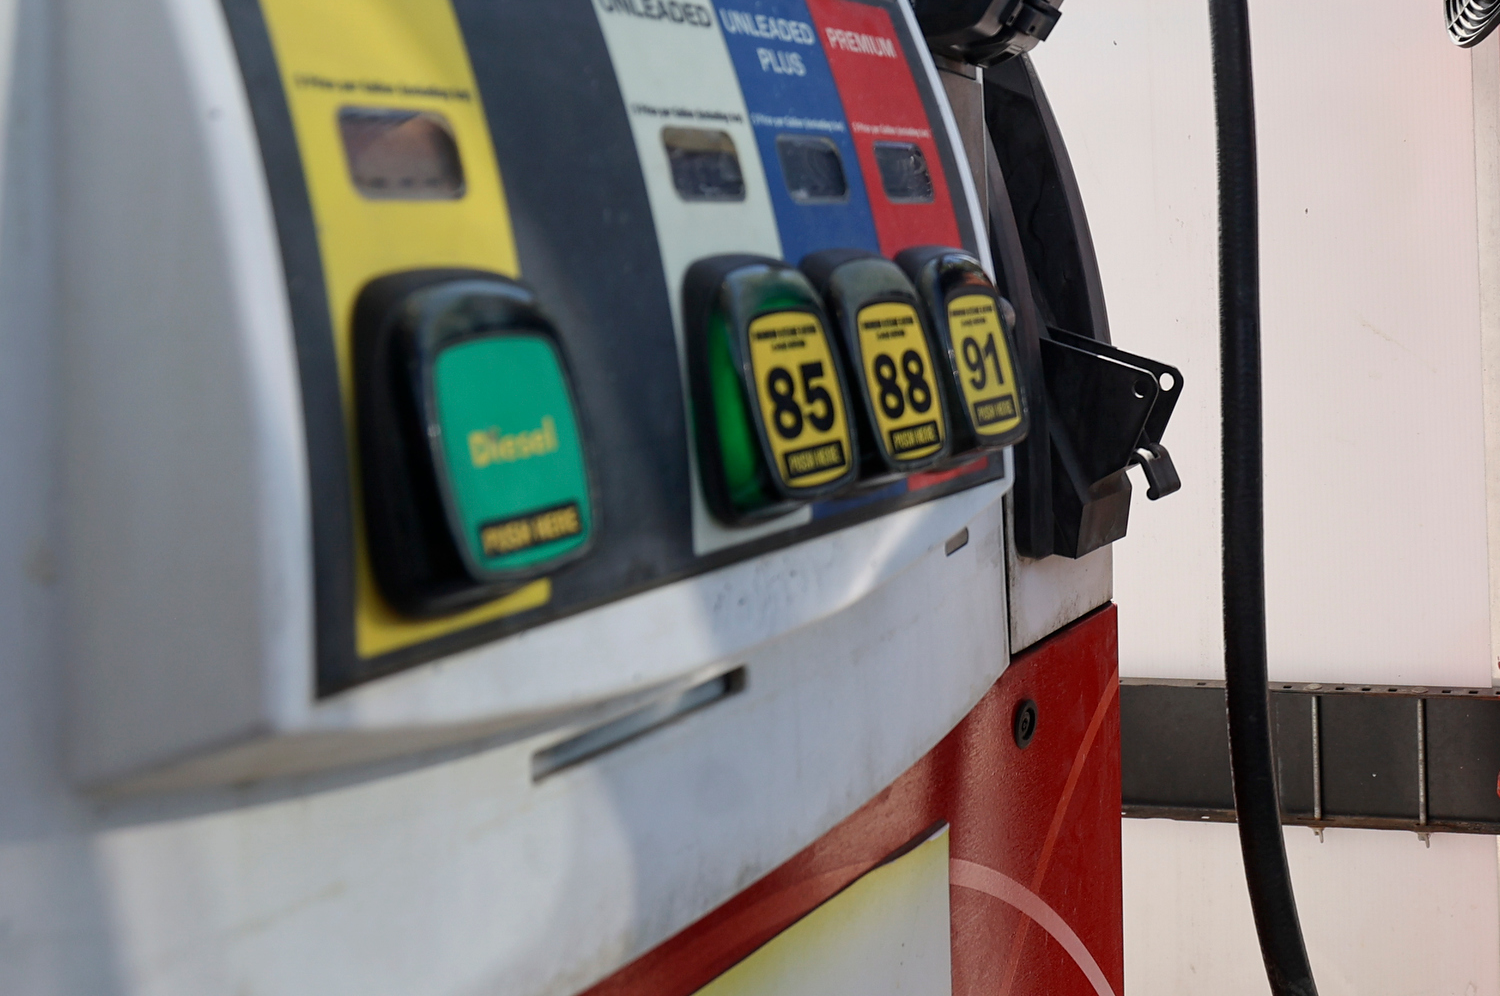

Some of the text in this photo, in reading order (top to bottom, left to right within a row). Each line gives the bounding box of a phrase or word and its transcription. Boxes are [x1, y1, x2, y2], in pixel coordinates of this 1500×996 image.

[719, 9, 816, 46] UNLEADED
[825, 27, 897, 59] PREMIUM
[756, 47, 806, 77] PLUS
[874, 350, 931, 419] 88
[962, 332, 1004, 390] 91
[768, 362, 835, 440] 85
[468, 415, 559, 468] Diesel
